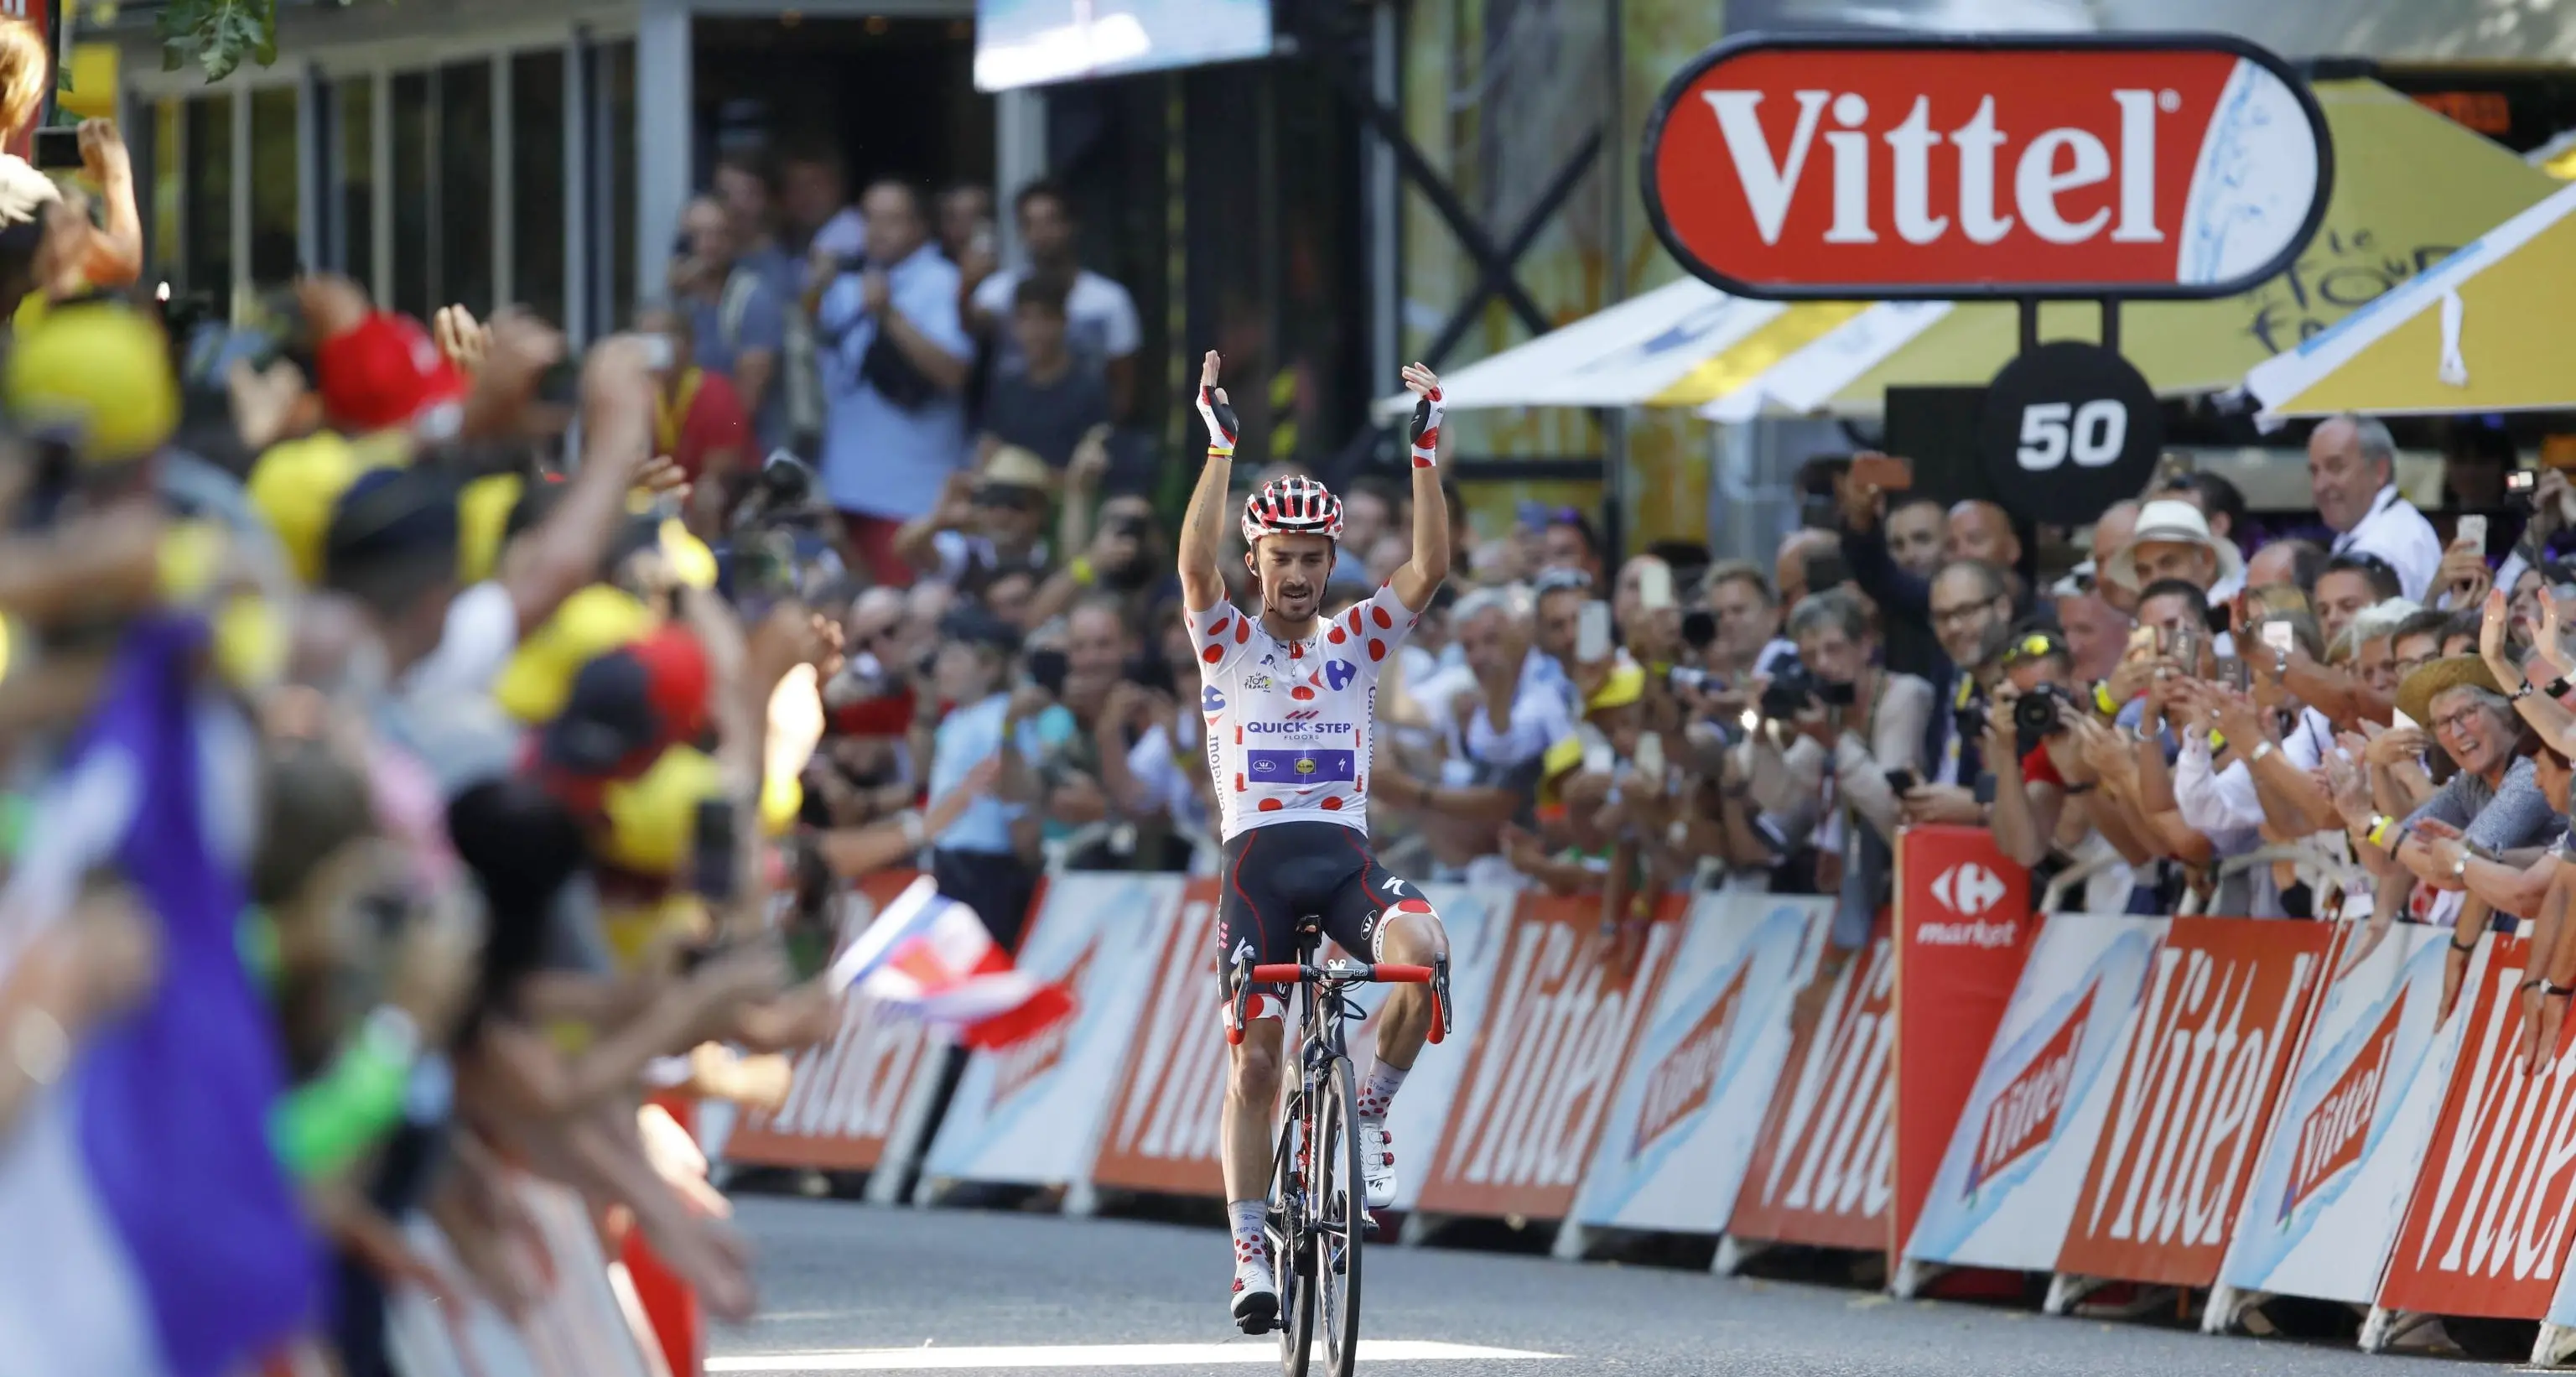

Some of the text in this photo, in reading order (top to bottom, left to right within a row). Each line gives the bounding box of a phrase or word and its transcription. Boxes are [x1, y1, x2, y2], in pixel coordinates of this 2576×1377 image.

[1701, 89, 2165, 246] Vittel
[2016, 398, 2128, 470] 50
[1916, 917, 2017, 949] market
[1980, 1020, 2085, 1177] Vittel
[2087, 946, 2310, 1247] Vittel
[2296, 1031, 2395, 1197] Vittel
